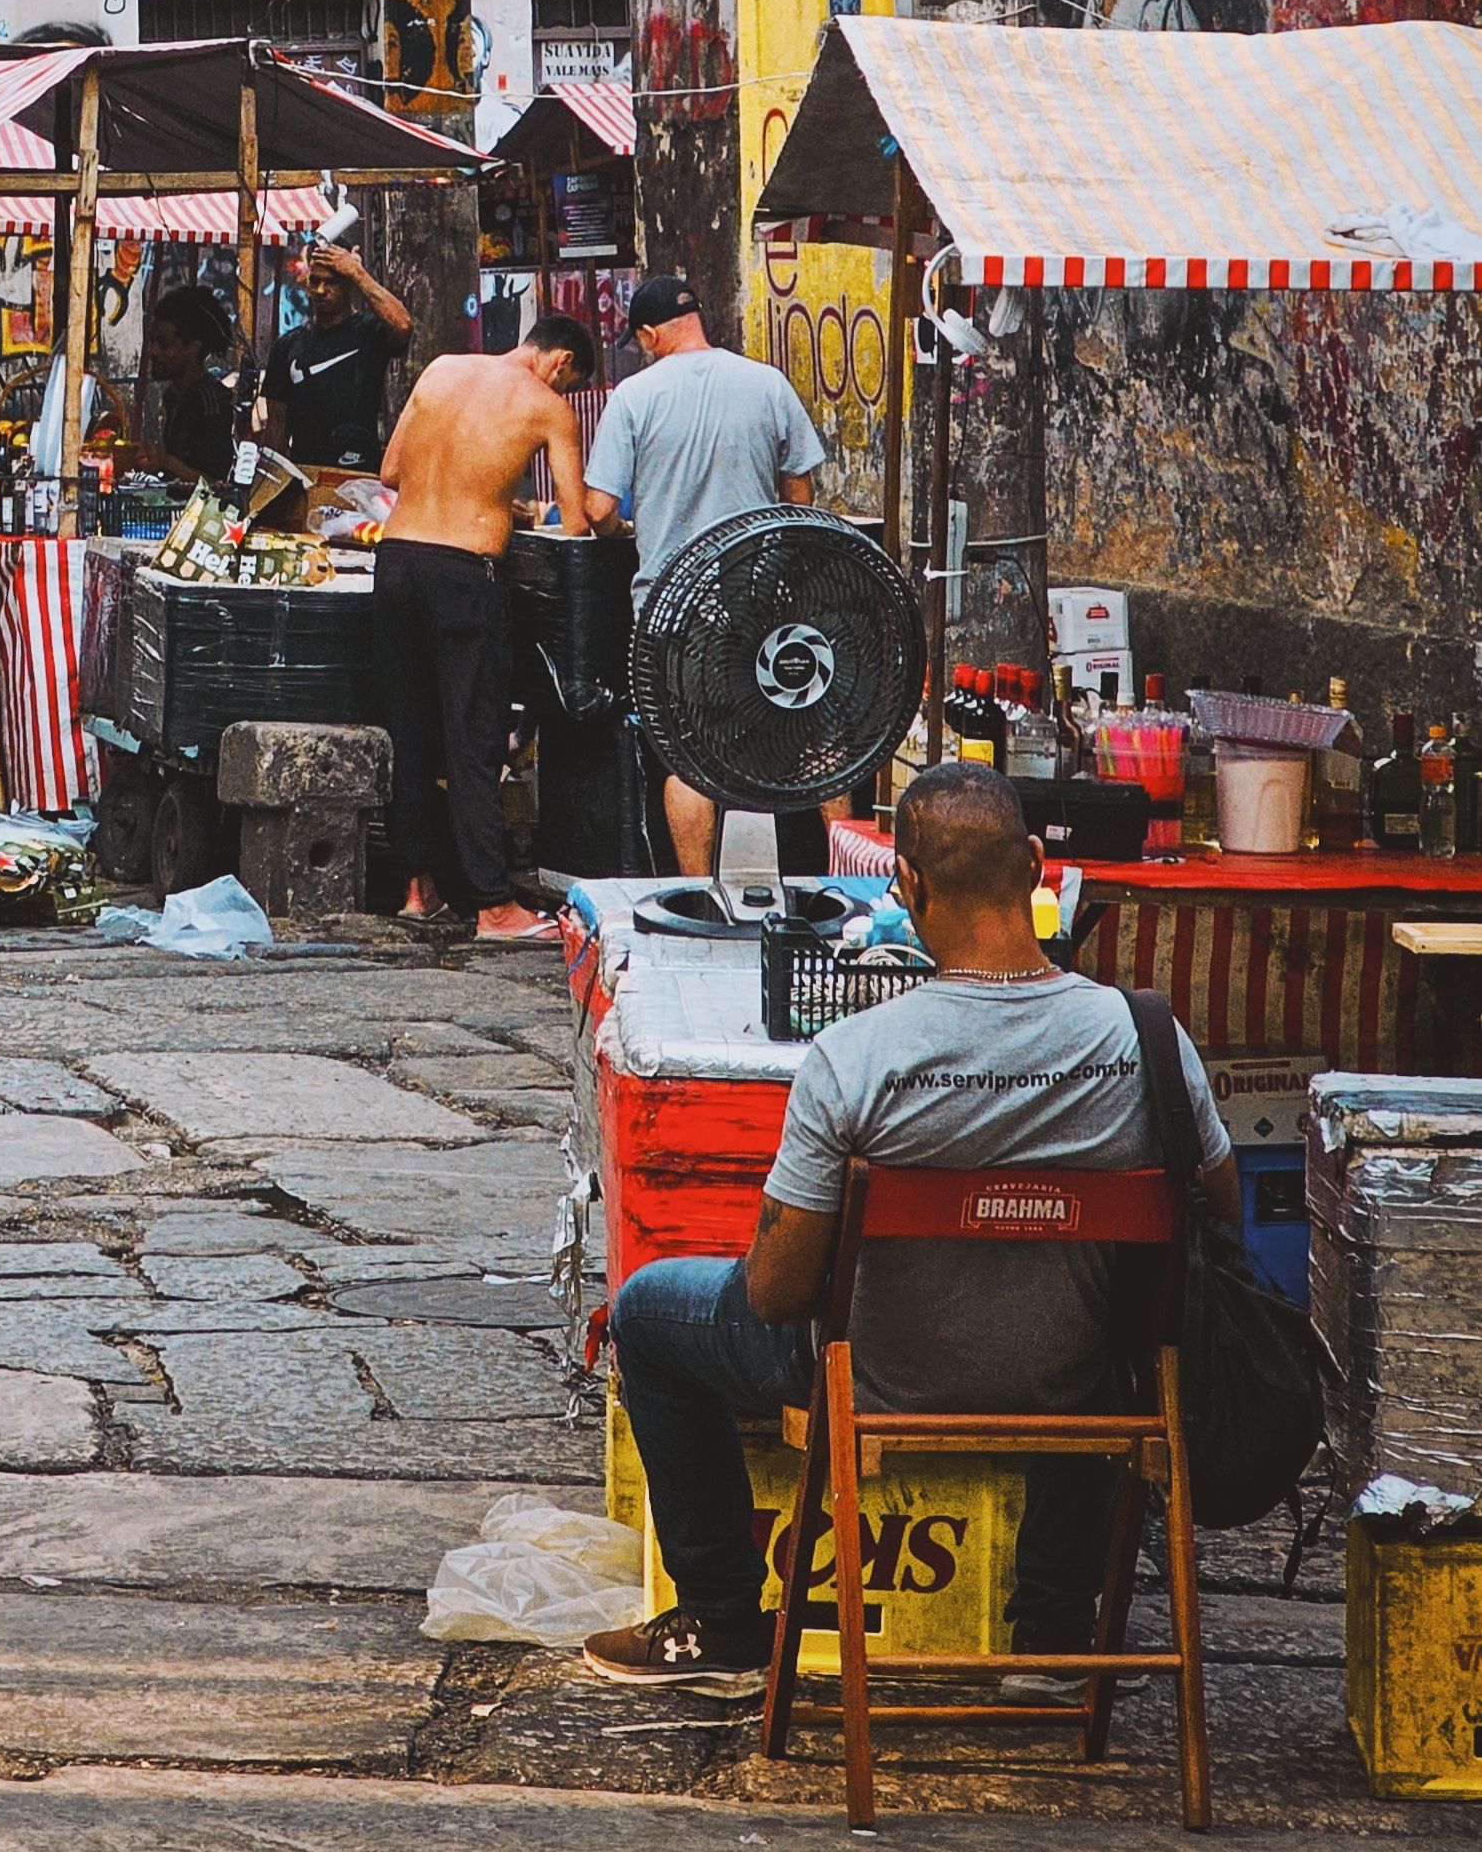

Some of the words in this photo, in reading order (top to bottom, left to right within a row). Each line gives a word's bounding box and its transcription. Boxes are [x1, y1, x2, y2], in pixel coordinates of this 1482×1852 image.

[545, 44, 574, 58] SUA
[575, 43, 611, 58] VIDA
[546, 65, 577, 76] VALE
[578, 65, 610, 77] MAIS
[884, 1057, 1138, 1093] www.servipromo.com.br
[986, 1182, 1061, 1194] CERVEJARIA
[976, 1197, 1066, 1220] BRAHMA
